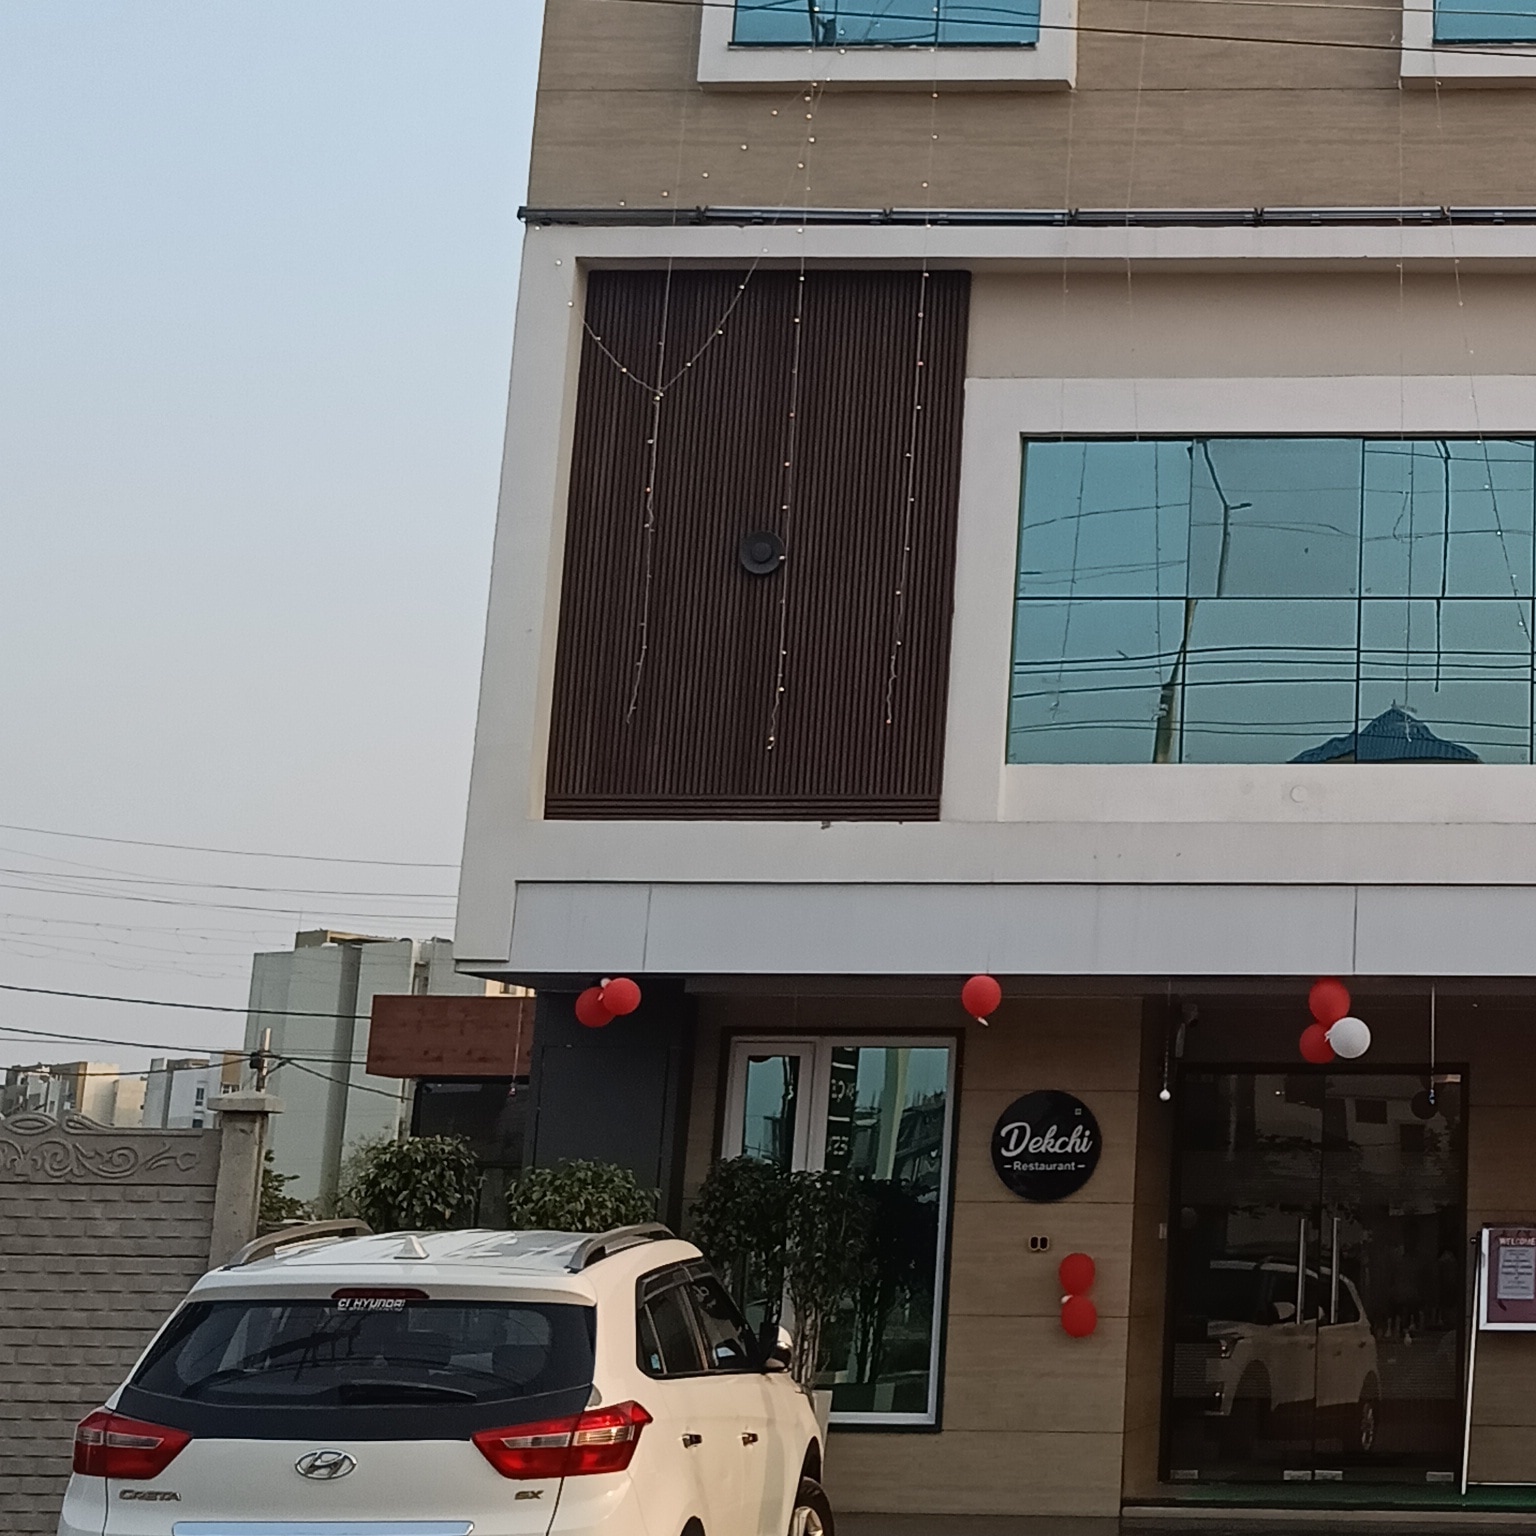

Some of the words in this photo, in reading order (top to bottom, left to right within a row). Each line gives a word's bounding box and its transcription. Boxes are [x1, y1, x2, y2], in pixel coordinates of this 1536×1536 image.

[1000, 1122, 1093, 1157] Dekchi
[1013, 1161, 1076, 1171] Restaurant
[1499, 1237, 1536, 1245] WELCOME
[119, 1489, 181, 1501] CRETA
